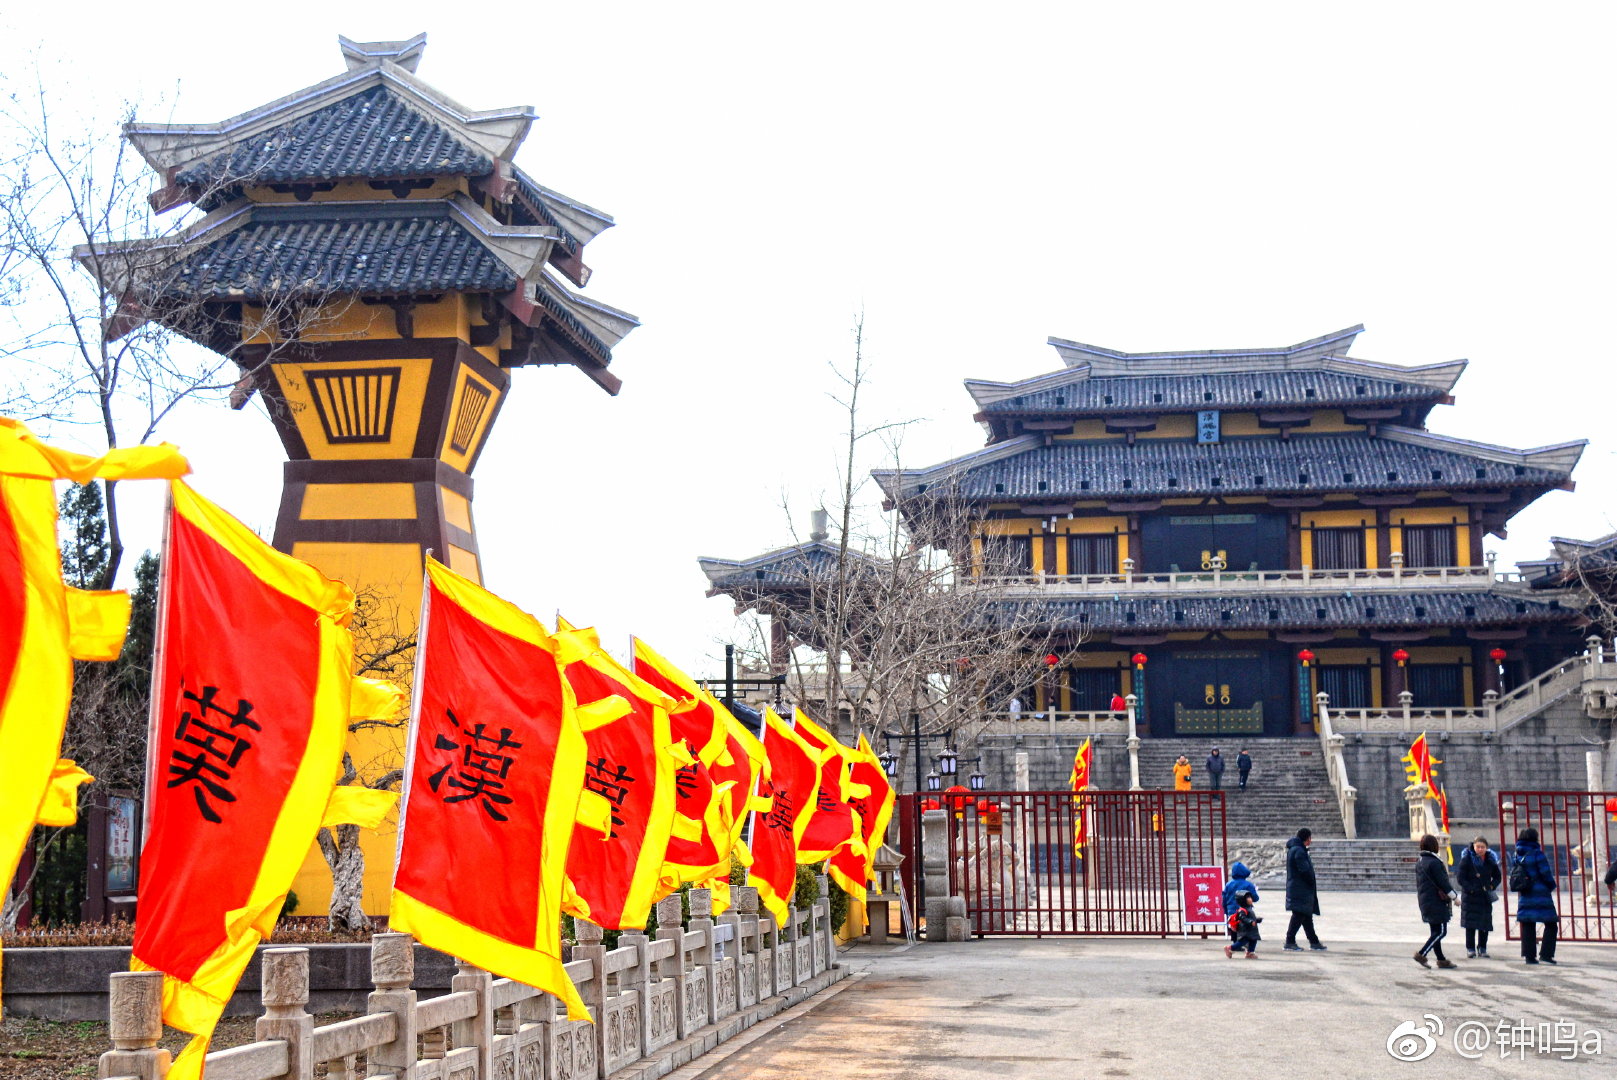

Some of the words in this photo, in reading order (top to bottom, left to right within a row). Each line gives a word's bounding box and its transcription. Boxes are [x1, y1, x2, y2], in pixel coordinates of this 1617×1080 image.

[427, 707, 523, 822] 漢
[1195, 882, 1213, 916] 售票处
